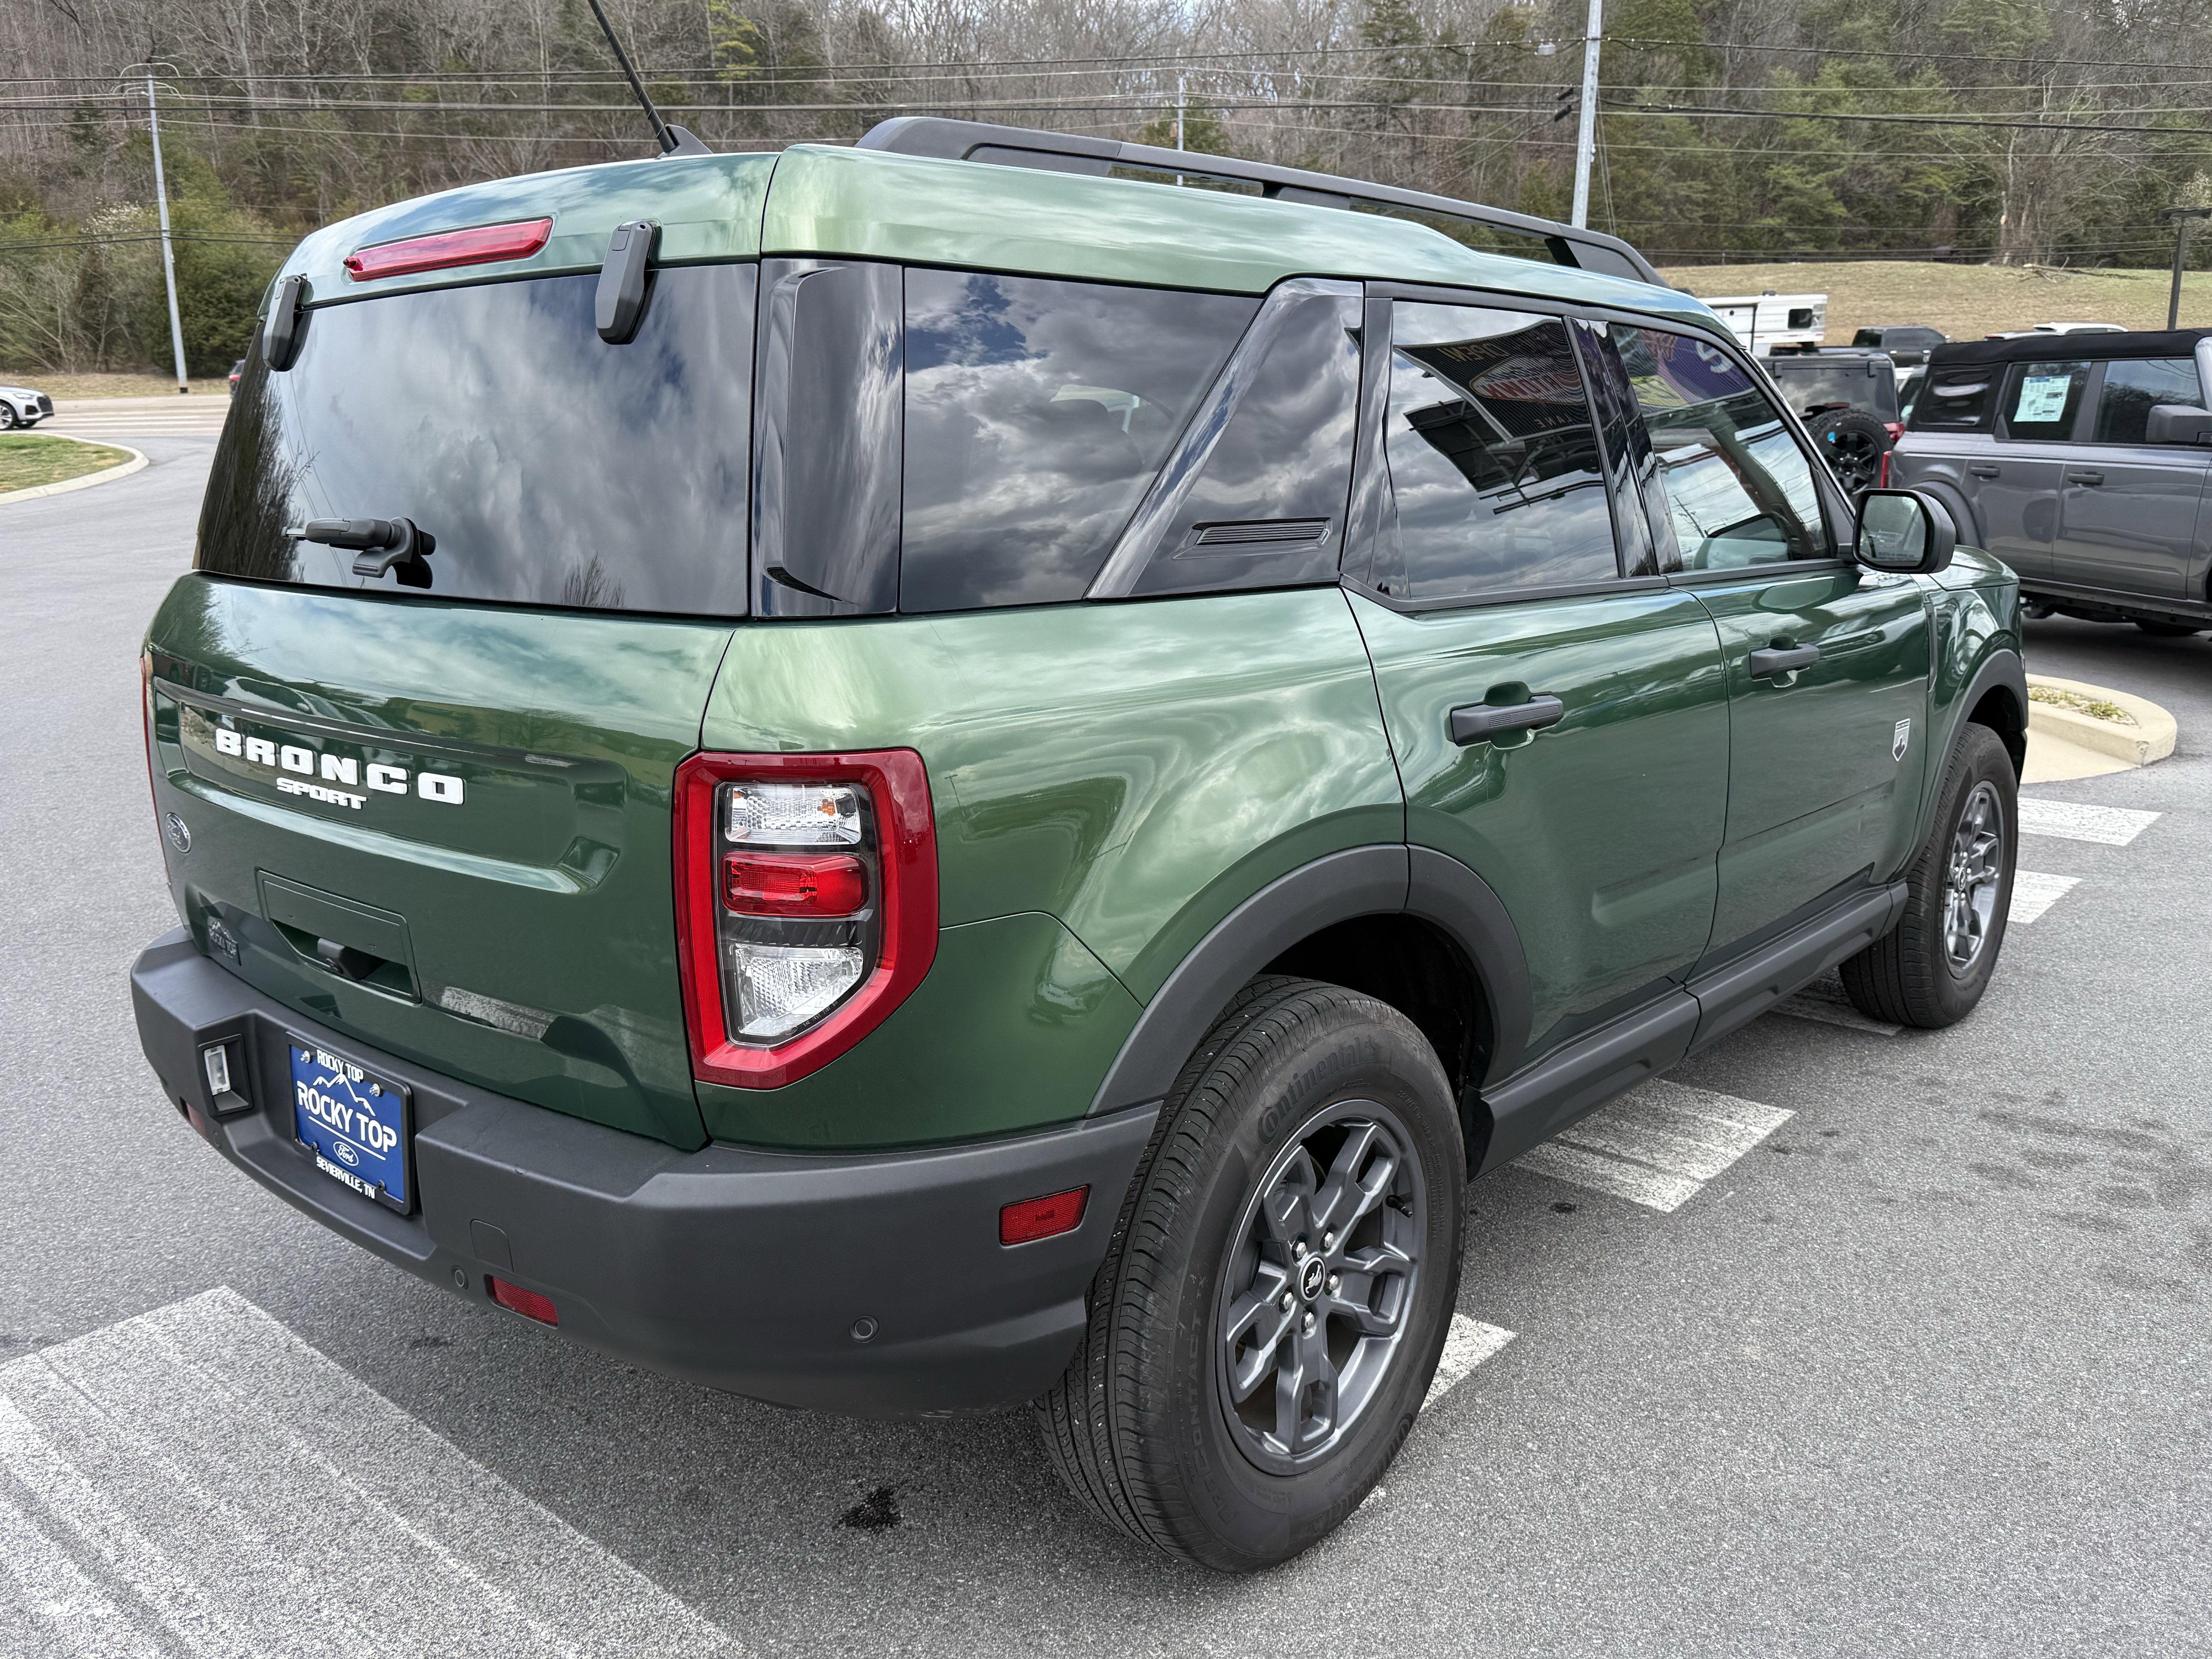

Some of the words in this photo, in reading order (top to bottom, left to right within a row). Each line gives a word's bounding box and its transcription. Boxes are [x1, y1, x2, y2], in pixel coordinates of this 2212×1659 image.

[216, 728, 464, 805] BRONCO
[276, 777, 367, 809] SPORT
[317, 1049, 344, 1074] ROCKY
[345, 1063, 364, 1083] TOP
[1258, 1036, 1361, 1145] Continental
[297, 1080, 353, 1133] ROCKY
[356, 1112, 397, 1152] TOP
[338, 1144, 354, 1163] Ford
[316, 1156, 363, 1193] SEVIERVILLE,
[363, 1183, 376, 1199] TN
